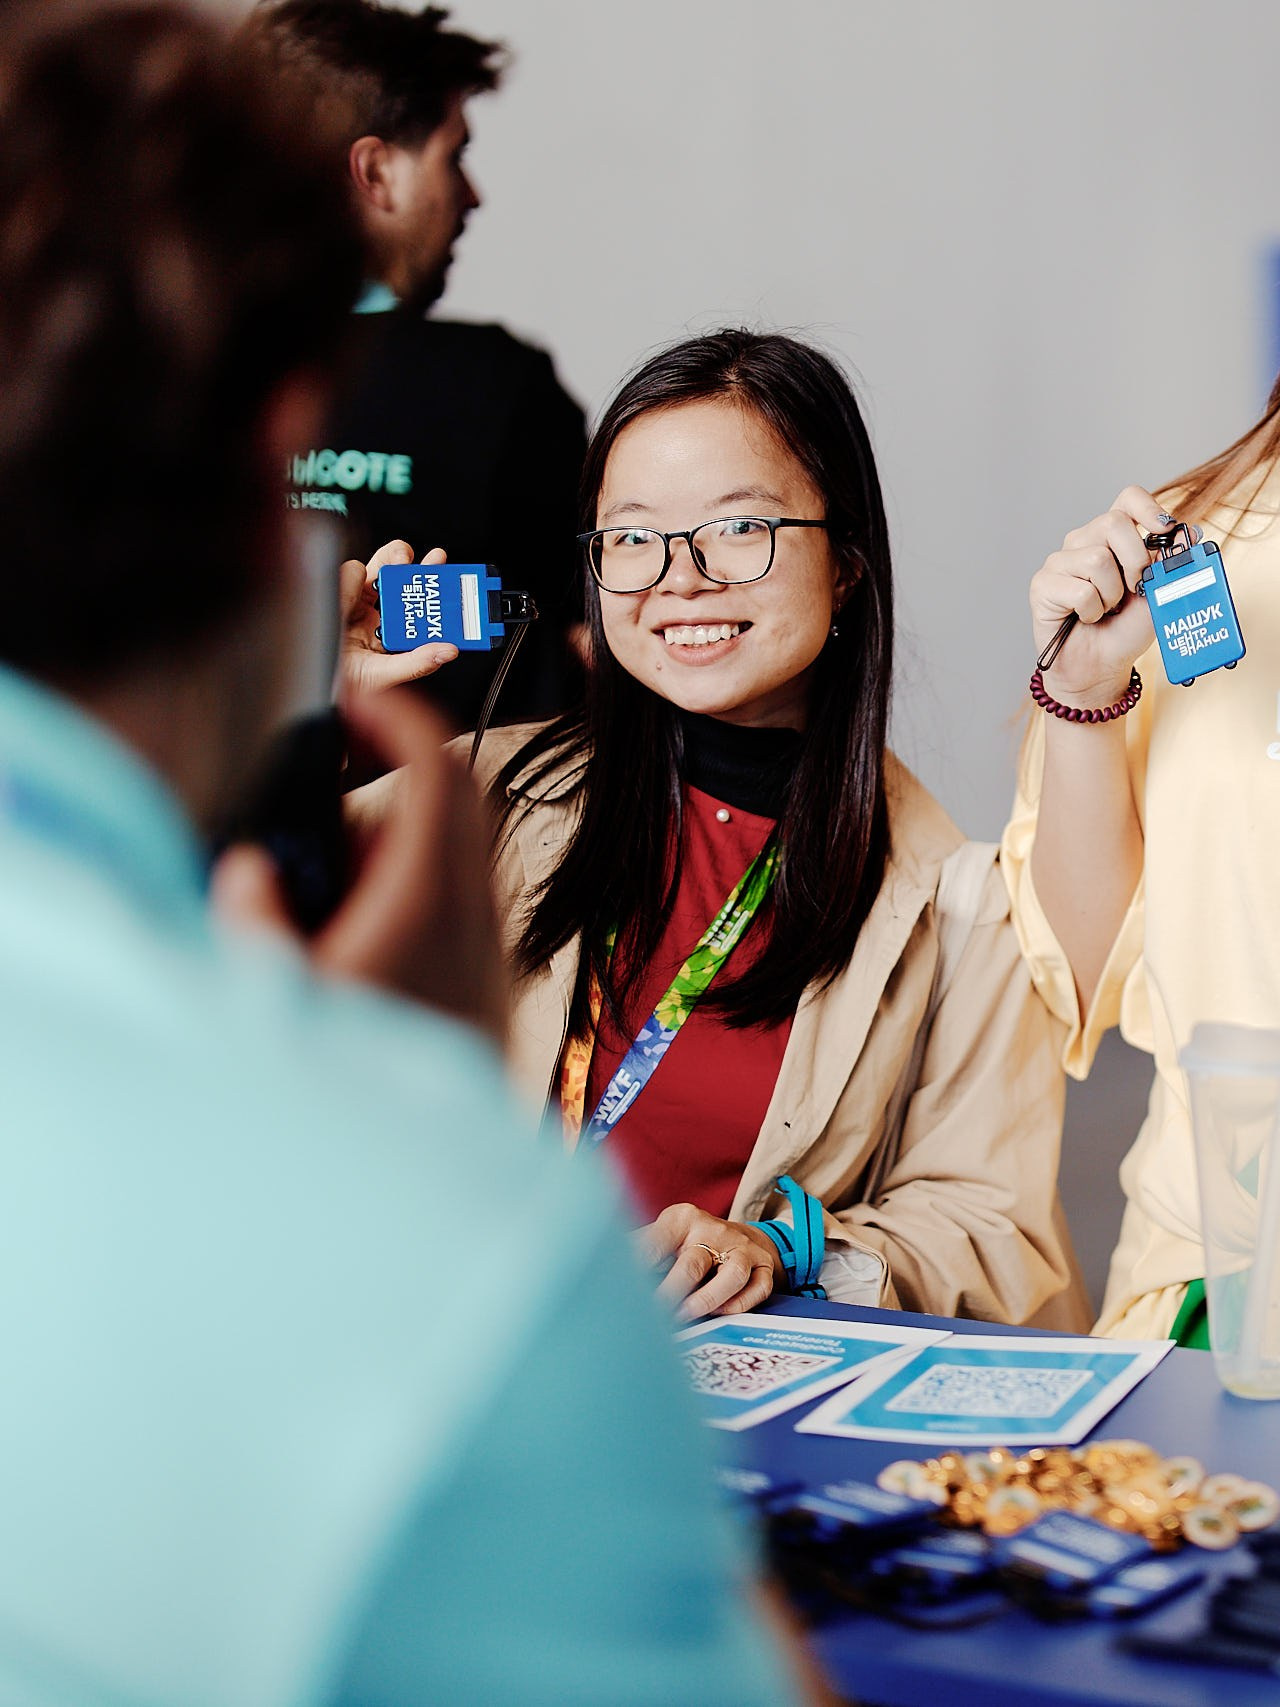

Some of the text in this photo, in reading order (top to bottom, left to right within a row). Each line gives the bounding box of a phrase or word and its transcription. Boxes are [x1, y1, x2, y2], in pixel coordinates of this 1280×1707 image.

[401, 584, 418, 640] ЗНАНИЙ
[411, 574, 425, 619] ЦЕНТР
[425, 574, 443, 639] МАШУК
[1163, 602, 1224, 640] МАШУК
[1167, 627, 1208, 652] ЦЕНТР
[1179, 626, 1229, 657] ЗНАНИЙ
[594, 1067, 634, 1123] WYF
